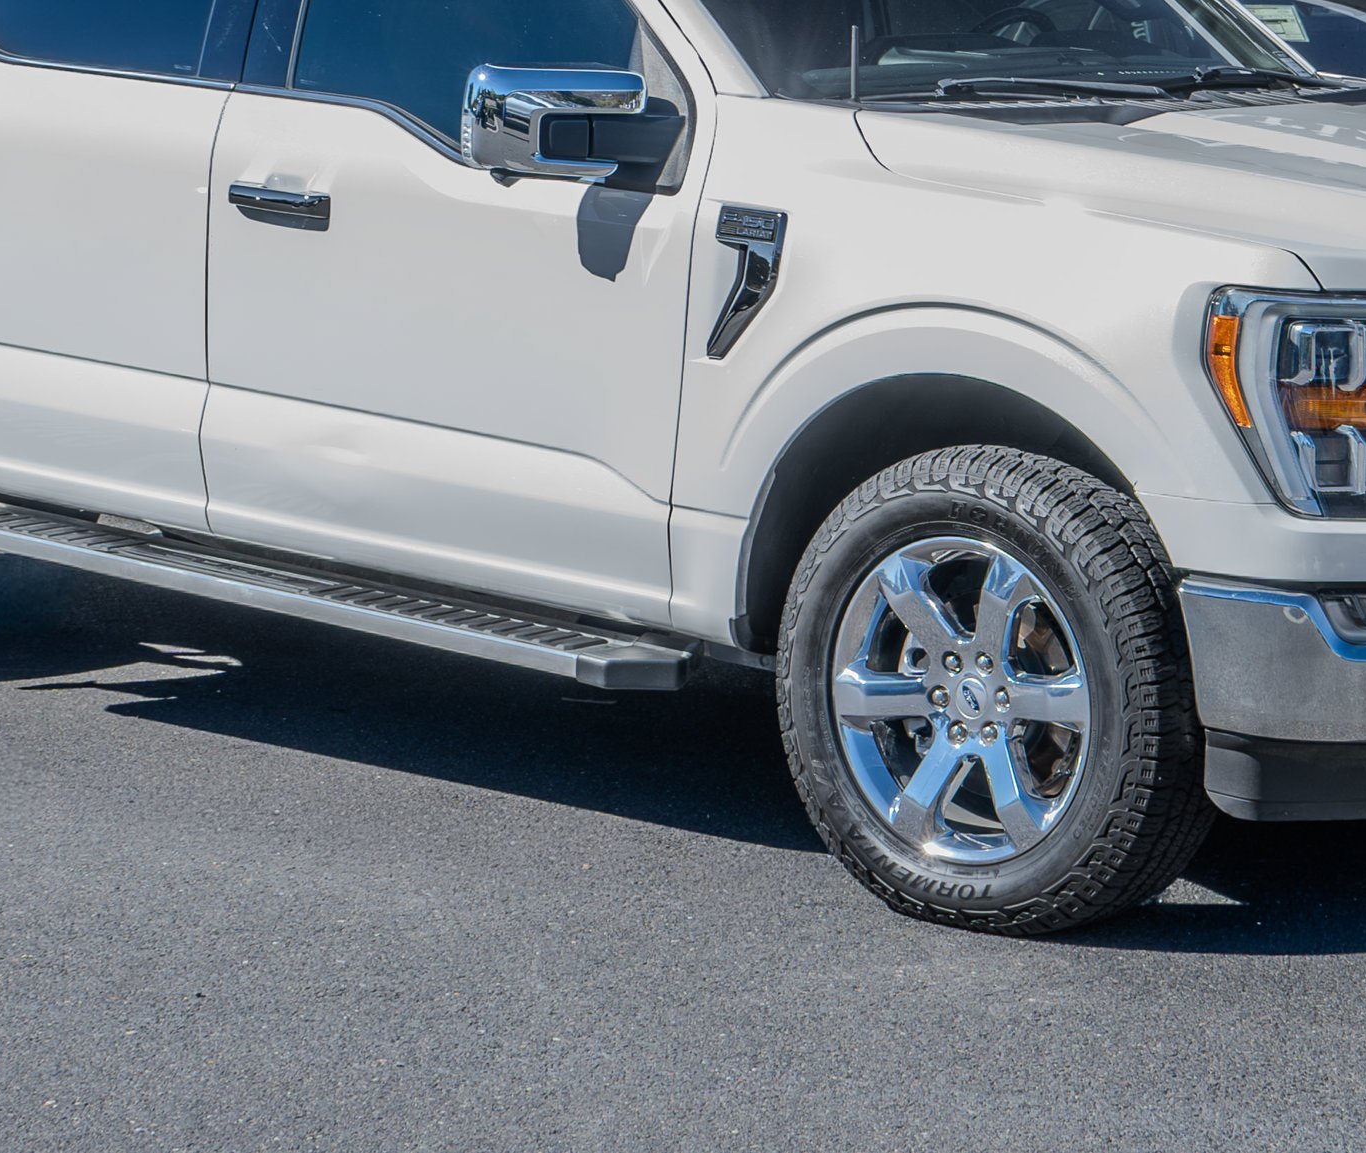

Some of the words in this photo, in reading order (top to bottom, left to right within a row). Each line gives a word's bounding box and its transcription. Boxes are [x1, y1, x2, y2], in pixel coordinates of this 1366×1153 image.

[721, 212, 775, 230] F-150
[735, 227, 773, 240] LARIAT
[947, 499, 1082, 601] FORTUNE
[847, 823, 994, 900] TORMENTA
